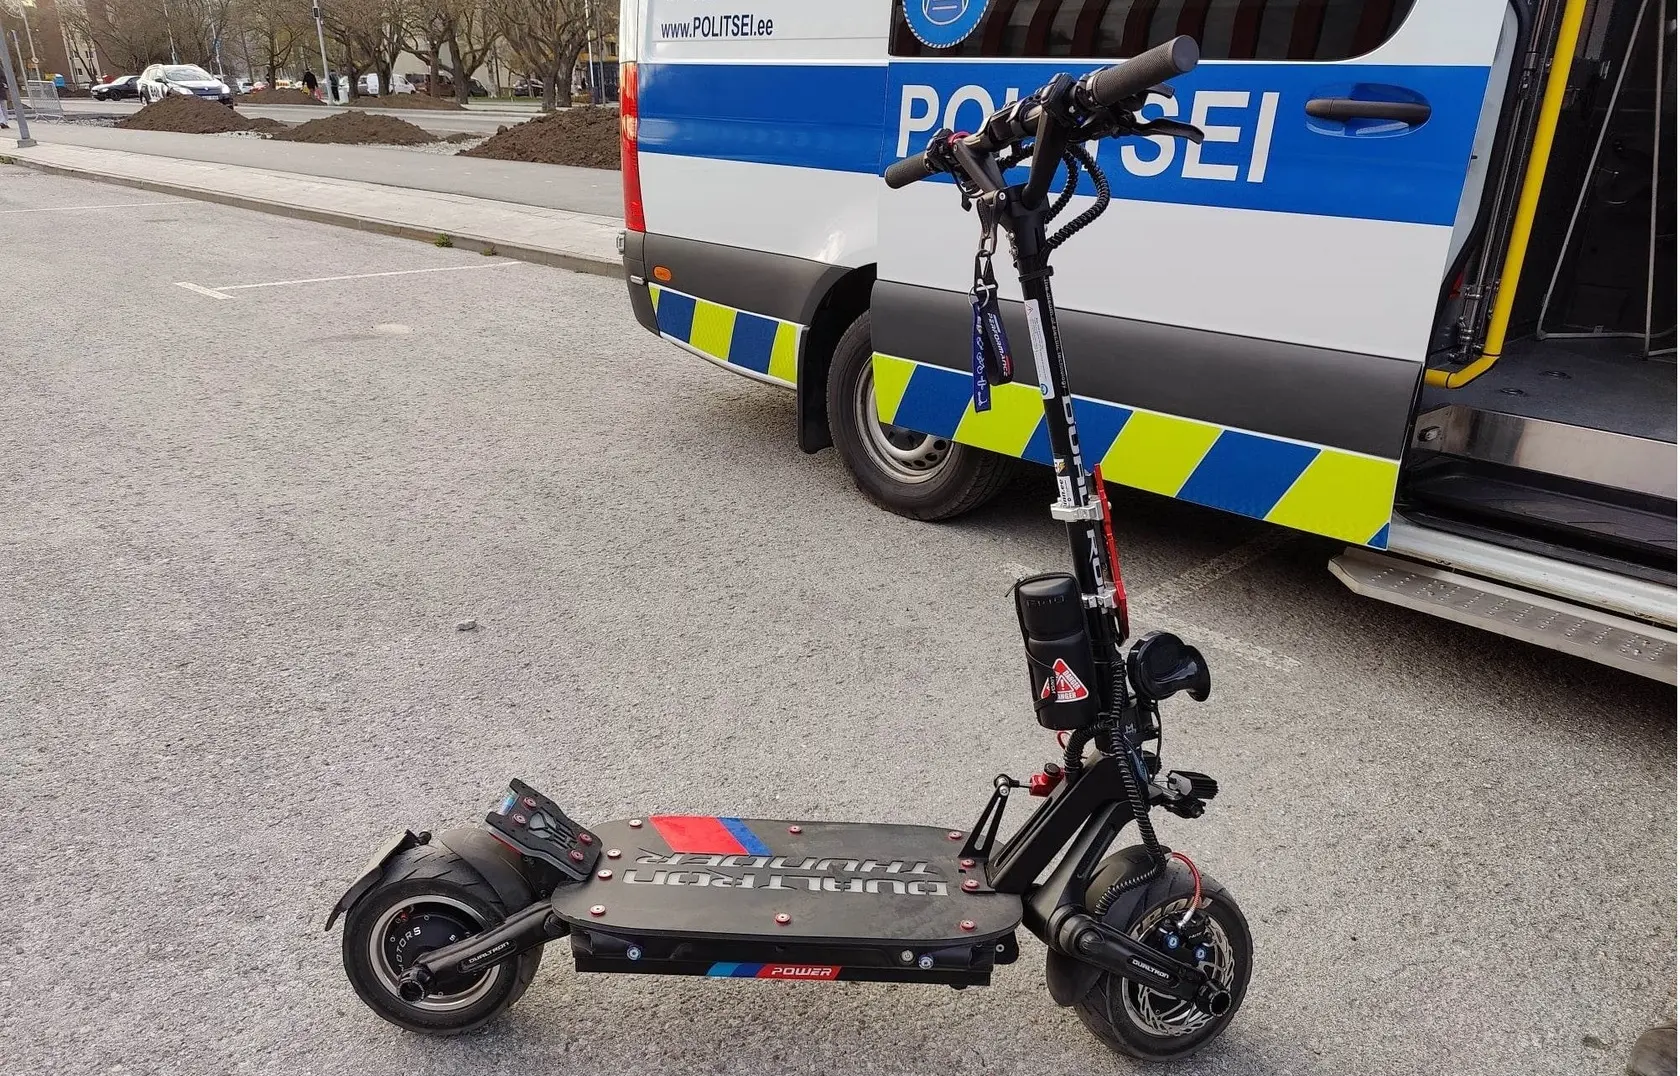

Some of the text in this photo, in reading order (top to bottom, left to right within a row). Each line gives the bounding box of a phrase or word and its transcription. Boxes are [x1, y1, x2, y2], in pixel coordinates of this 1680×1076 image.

[661, 14, 773, 38] www.POLITSEI.ee
[896, 84, 1280, 184] POSEI
[987, 312, 1008, 377] PERFORMANCE
[1056, 691, 1077, 700] ANGER
[636, 848, 939, 875] THUNDER
[622, 868, 949, 896] DUALTRON
[469, 941, 510, 963] DUALTRON
[771, 967, 832, 976] POWER
[1132, 958, 1170, 979] DUALTRON
